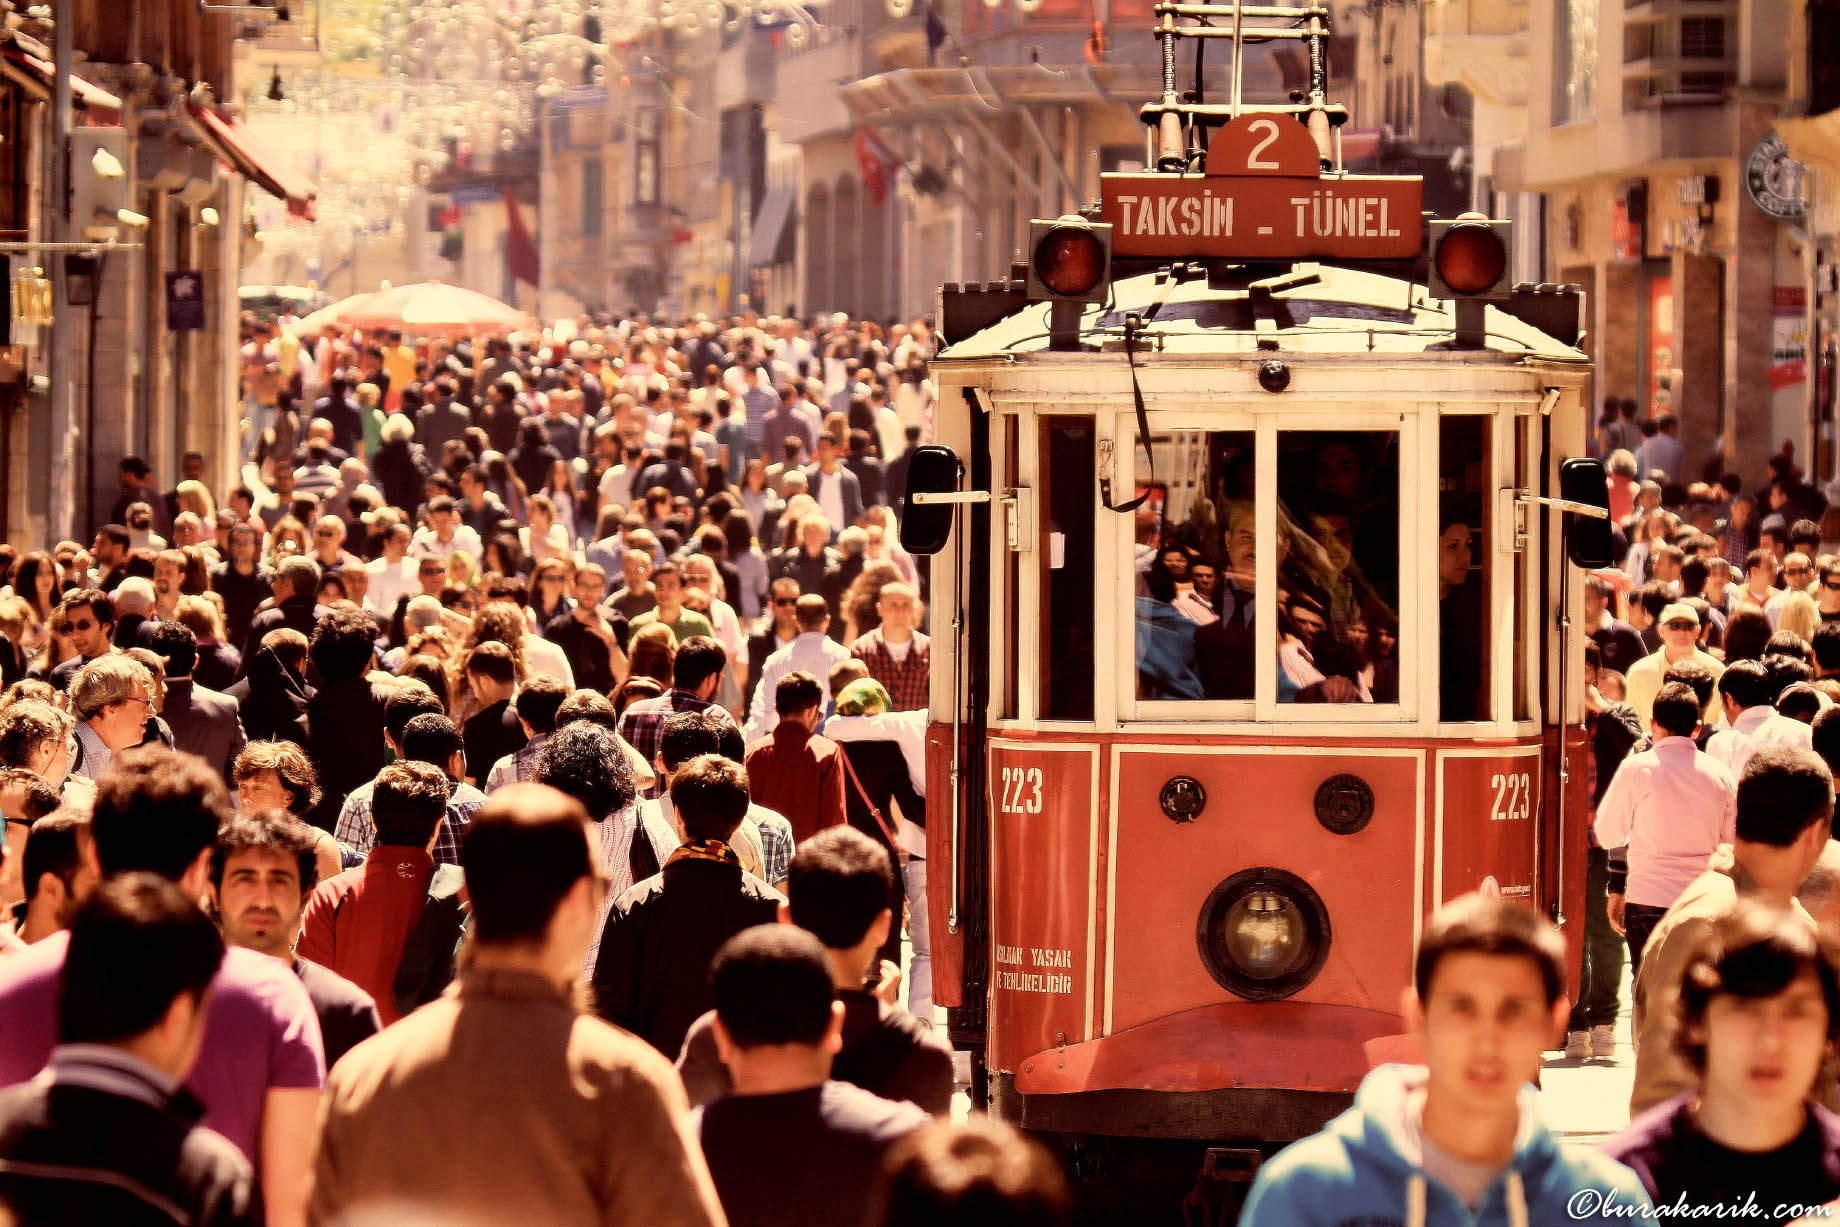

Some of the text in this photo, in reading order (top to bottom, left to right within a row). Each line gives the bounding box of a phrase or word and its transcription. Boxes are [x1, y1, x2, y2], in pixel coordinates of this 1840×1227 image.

[1247, 119, 1280, 170] 2
[1117, 189, 1234, 236] TAKSİM
[1290, 190, 1401, 237] TÜNEL
[1001, 767, 1043, 814] 223
[1491, 772, 1530, 820] 223
[1030, 947, 1072, 968] YASAK
